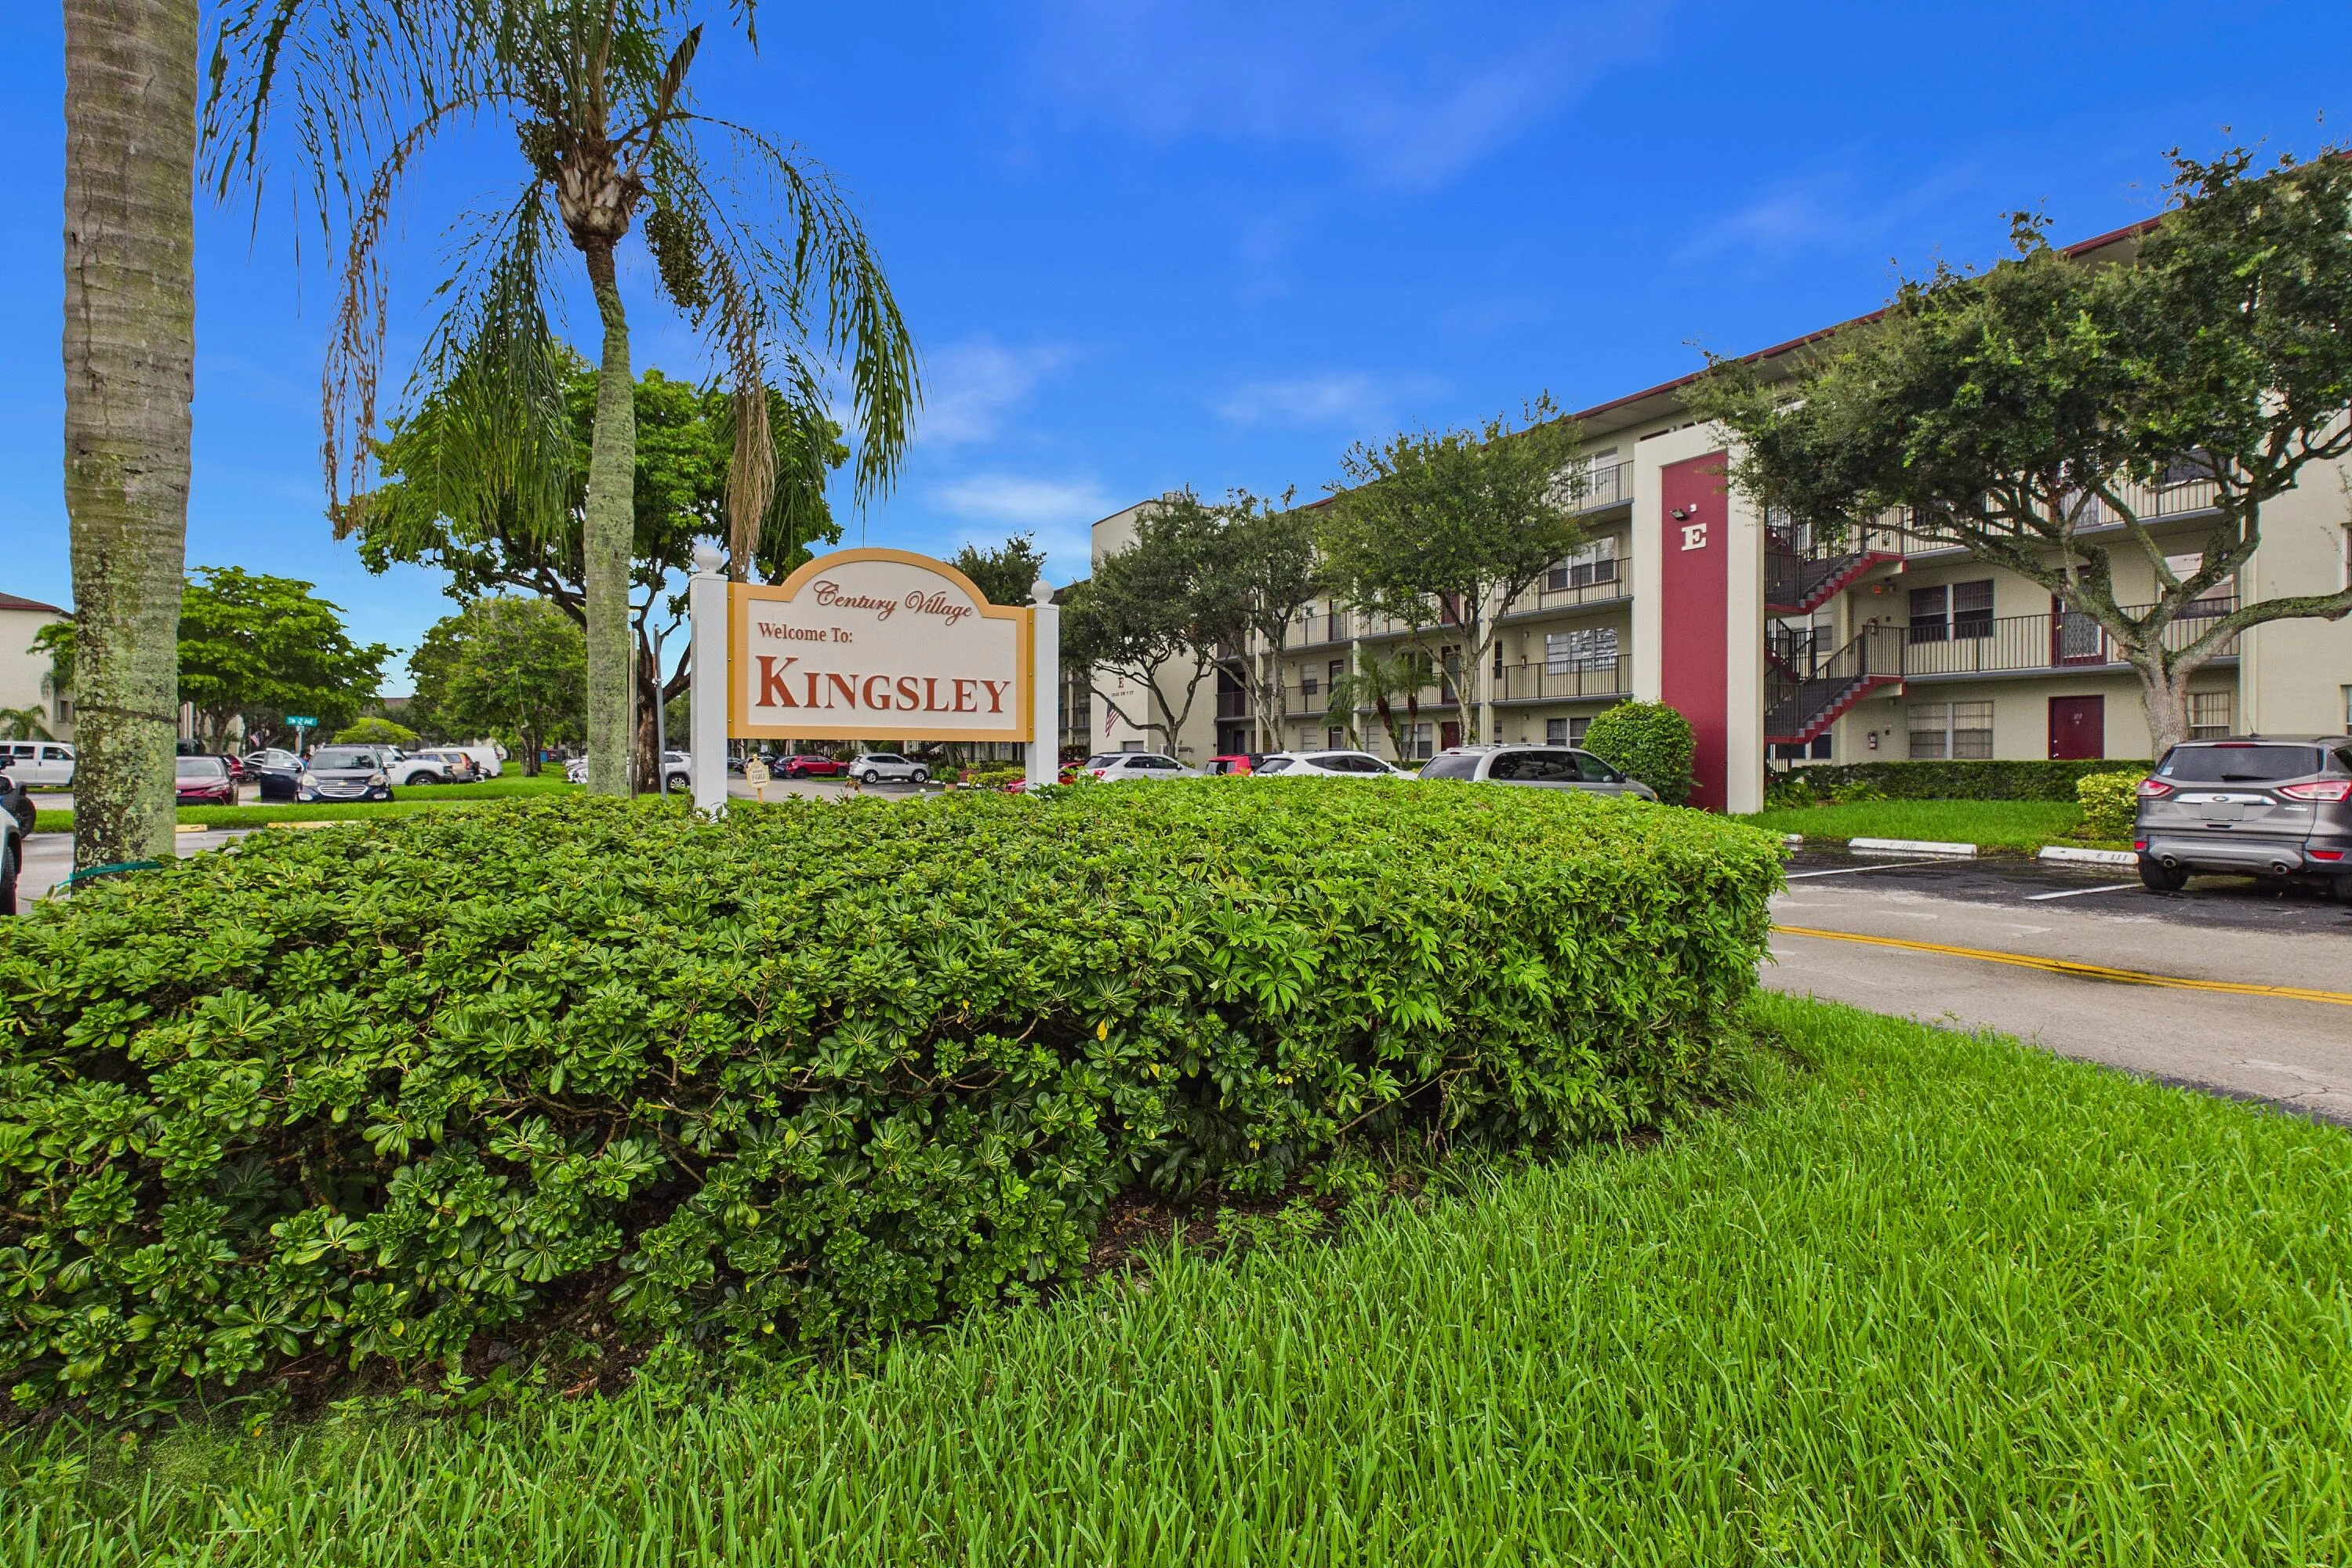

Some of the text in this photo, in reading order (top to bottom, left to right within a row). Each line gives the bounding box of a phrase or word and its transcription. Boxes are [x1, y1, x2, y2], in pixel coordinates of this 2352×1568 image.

[1682, 523, 1707, 551] E
[814, 580, 972, 626] Century Village
[757, 622, 853, 643] Welcome To:
[755, 655, 1011, 713] KINGSLEY
[1118, 677, 1124, 688] E
